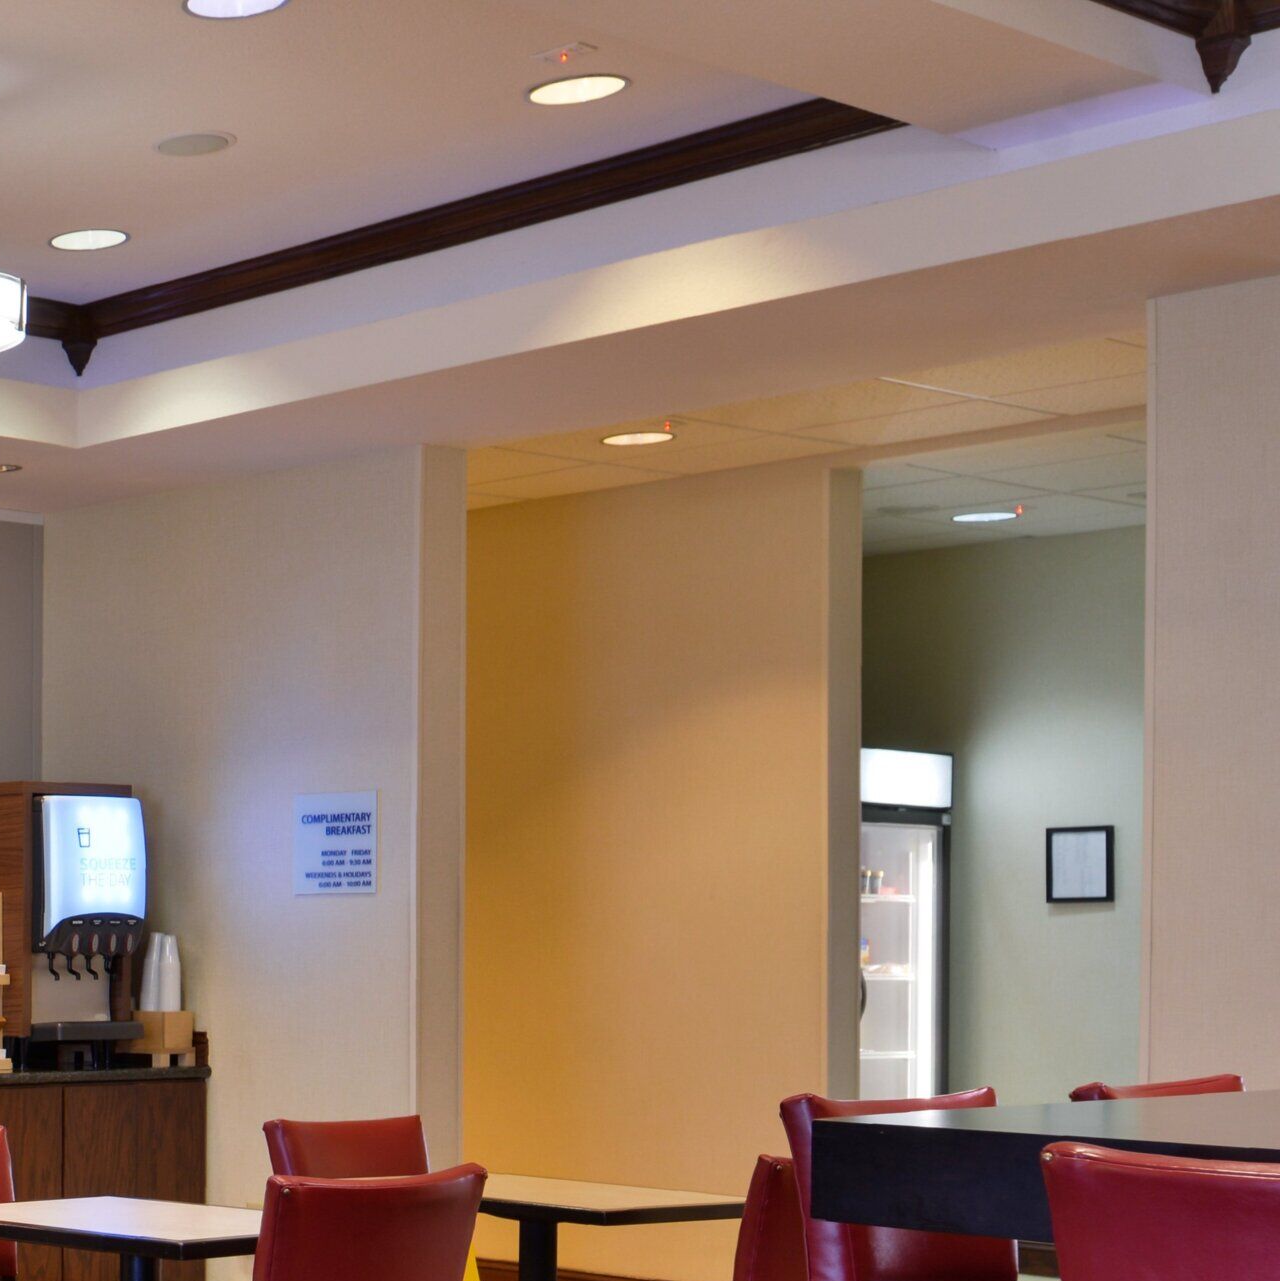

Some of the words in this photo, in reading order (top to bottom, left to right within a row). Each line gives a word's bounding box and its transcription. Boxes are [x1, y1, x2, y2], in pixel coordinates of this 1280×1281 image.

[301, 812, 371, 824] COMPLIMENTARY
[325, 825, 371, 836] BREAKFAST
[80, 858, 136, 871] SQUEEZE
[80, 873, 104, 887] THE
[109, 873, 132, 887] DAY
